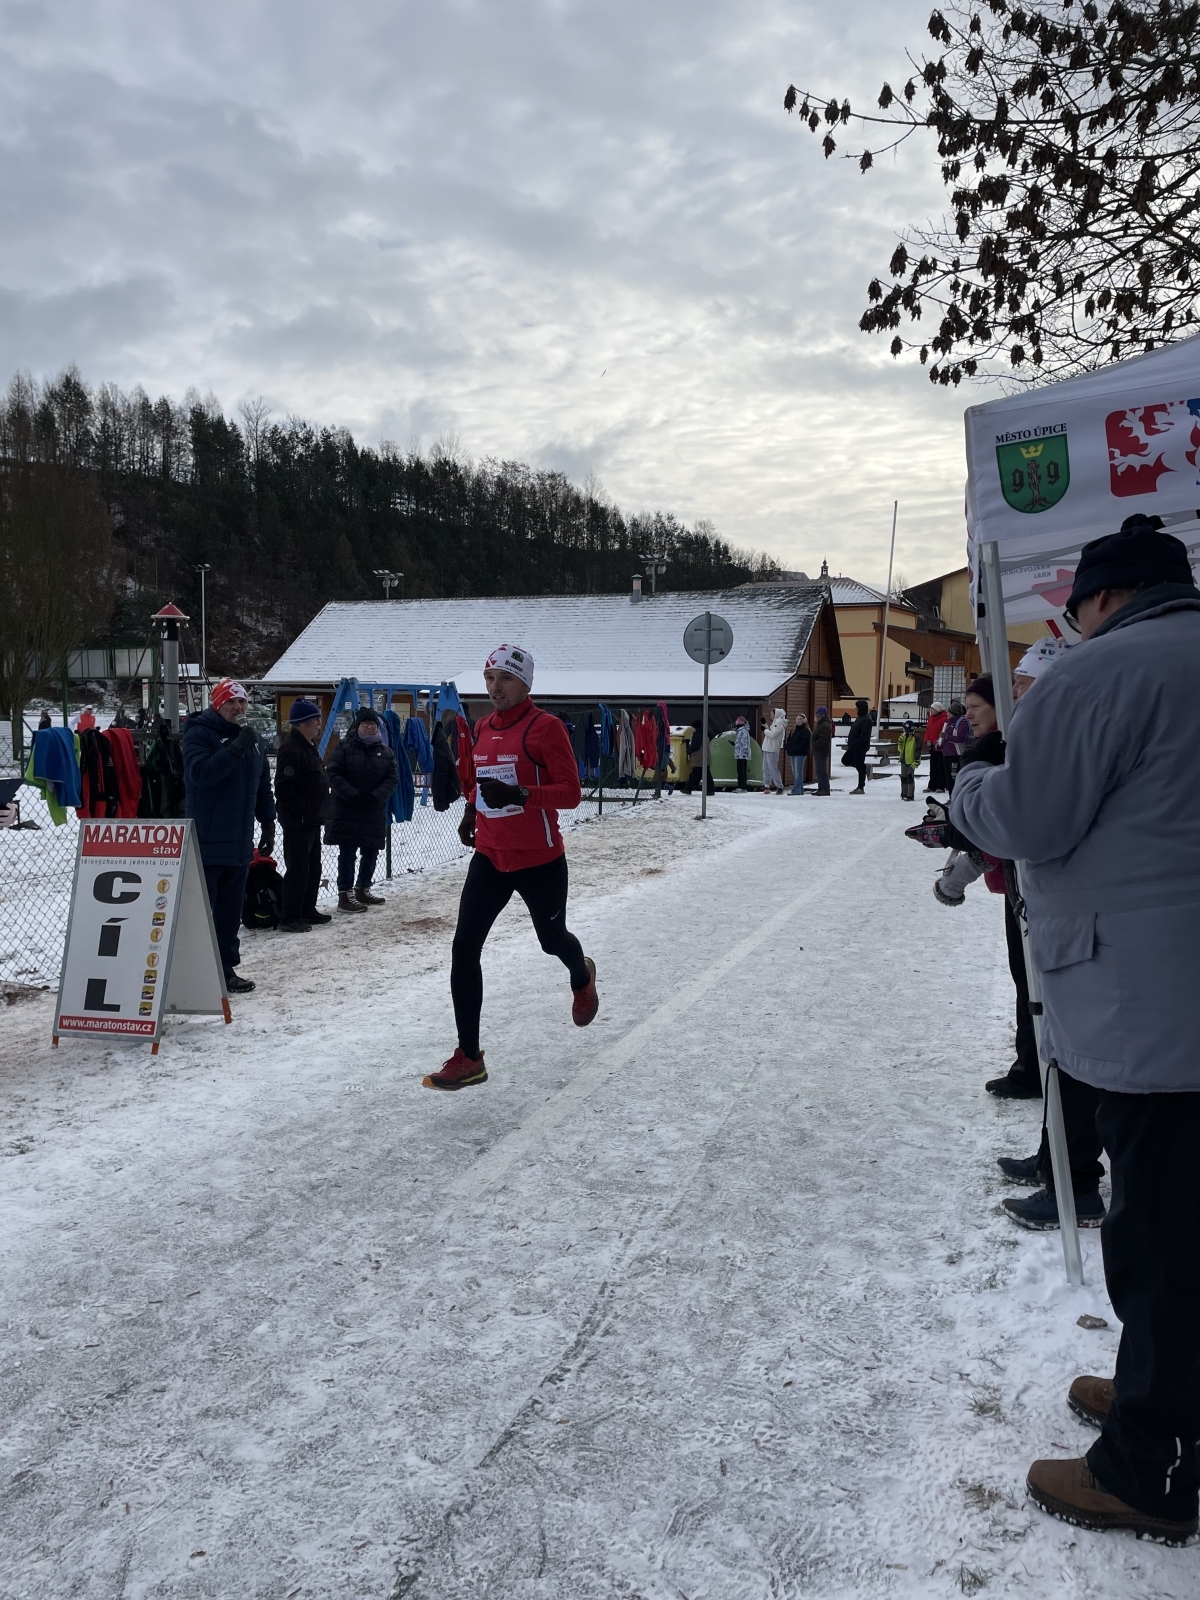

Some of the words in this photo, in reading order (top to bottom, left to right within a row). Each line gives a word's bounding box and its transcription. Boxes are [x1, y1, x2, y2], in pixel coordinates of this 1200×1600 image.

[995, 431, 1031, 444] MĚSTO
[1034, 423, 1067, 437] ÚPICE
[83, 825, 184, 844] MARATON
[152, 845, 178, 855] stav
[129, 859, 156, 867] jednota
[160, 858, 180, 867] Úpice
[84, 870, 142, 1012] CÍL
[62, 1018, 152, 1032] www.maratonstav.cz
